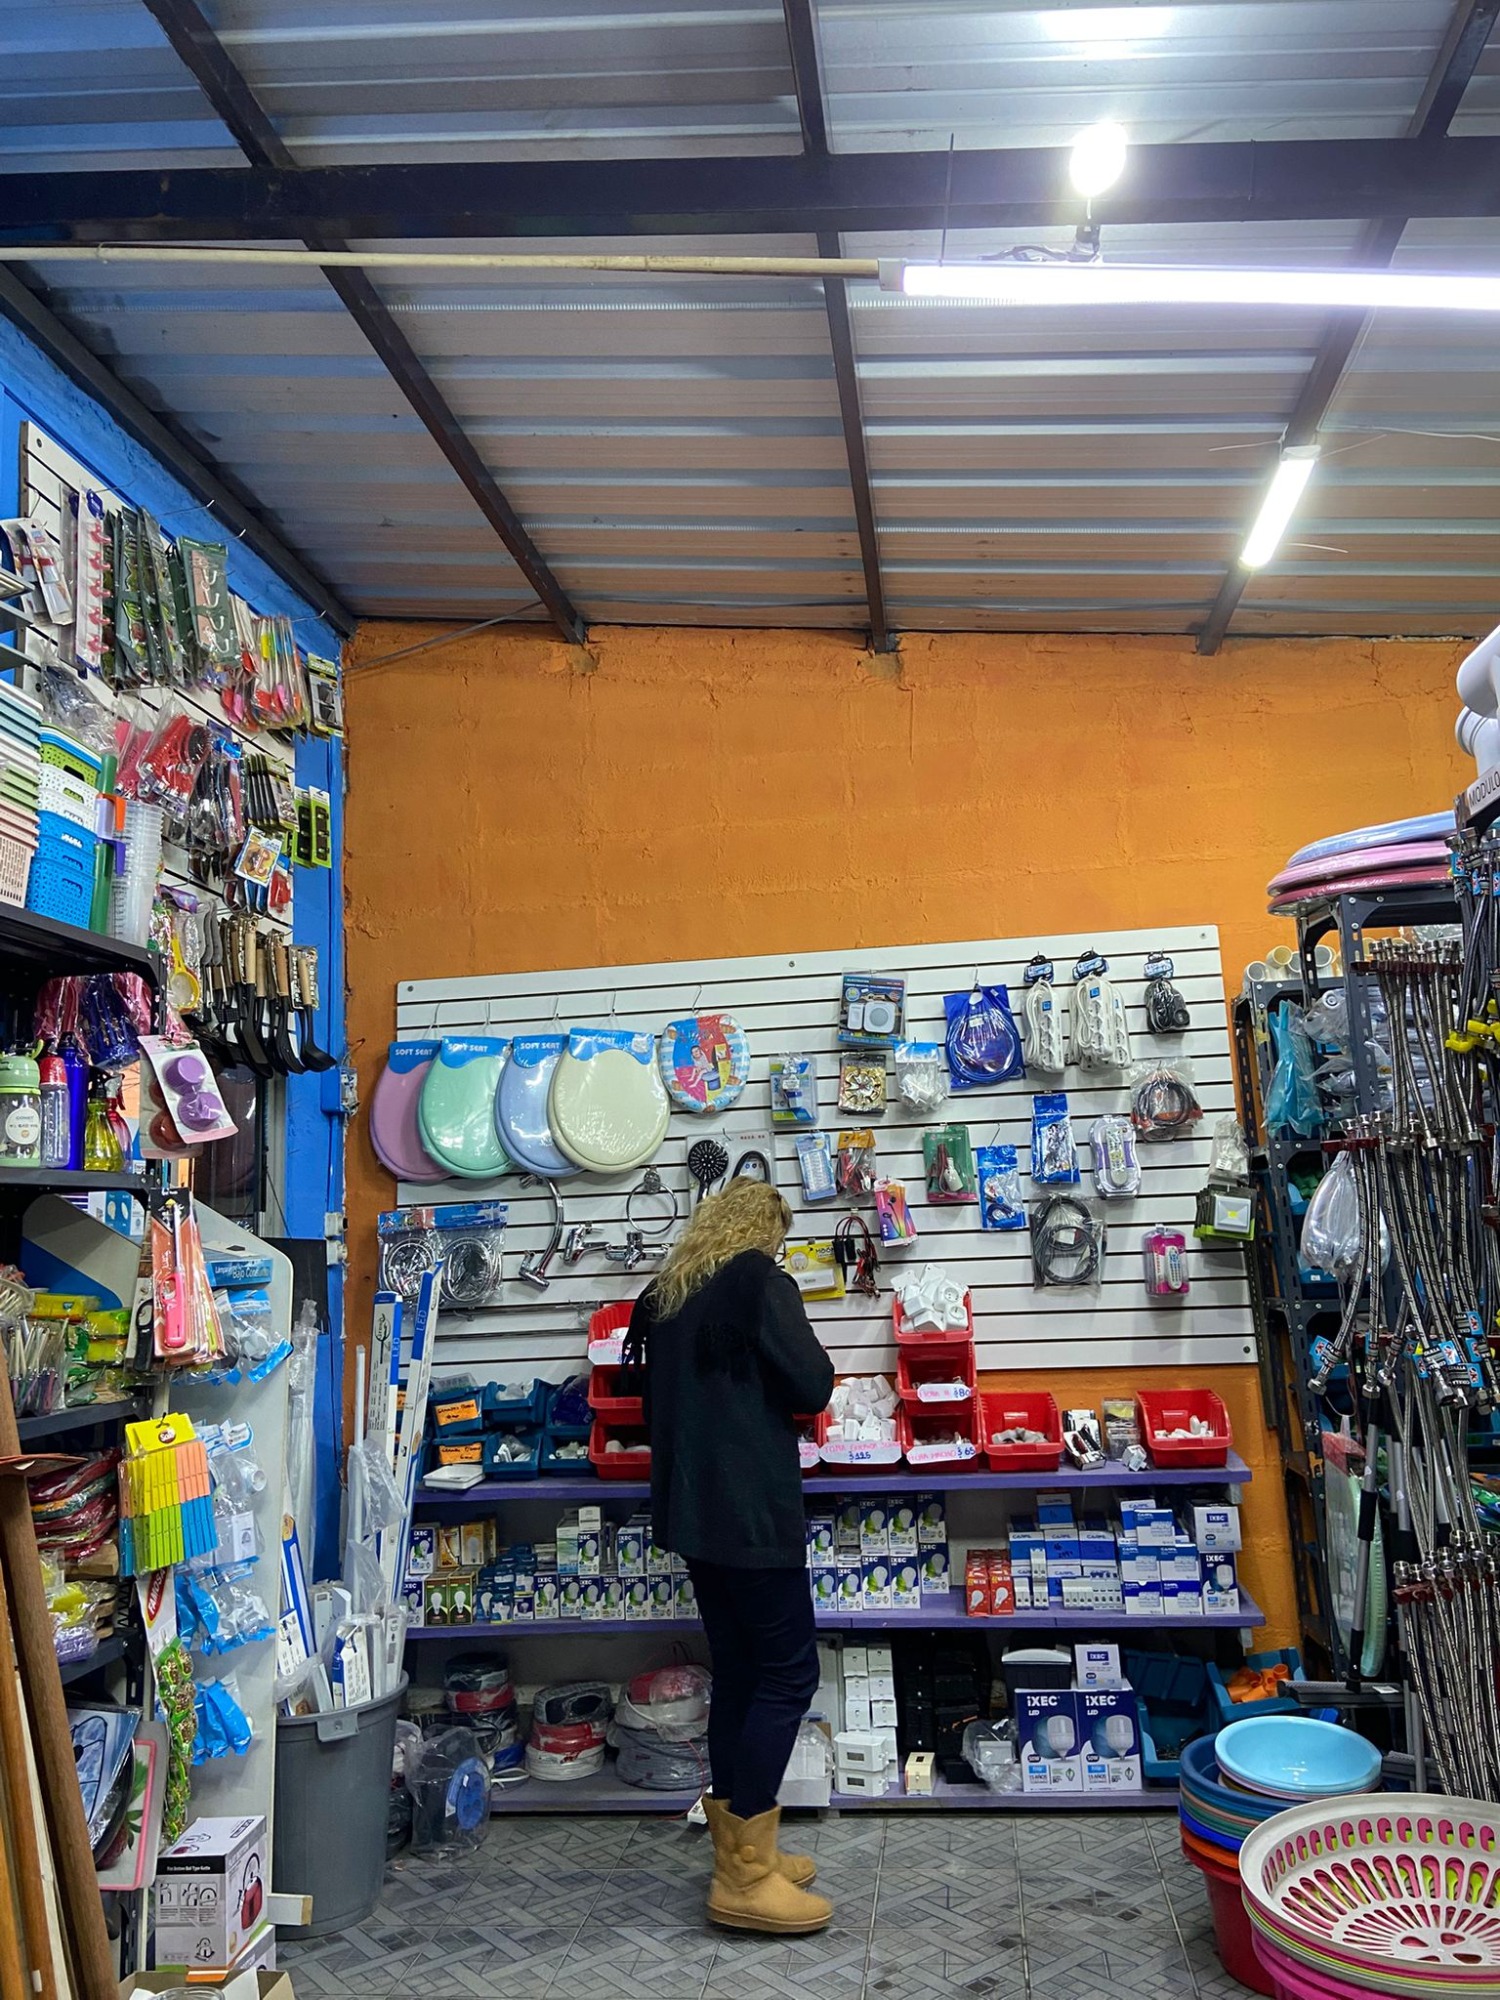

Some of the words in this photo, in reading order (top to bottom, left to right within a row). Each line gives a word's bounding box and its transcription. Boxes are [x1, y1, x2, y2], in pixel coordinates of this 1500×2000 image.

[469, 1045, 489, 1053] SEAT
[520, 1042, 540, 1050] SOFT
[541, 1042, 560, 1050] SEAT
[415, 1048, 433, 1056] SEAT
[416, 1310, 427, 1332] LED
[391, 1337, 401, 1358] LED
[1027, 1696, 1058, 1707] iXEC
[1085, 1695, 1117, 1706] iXEC
